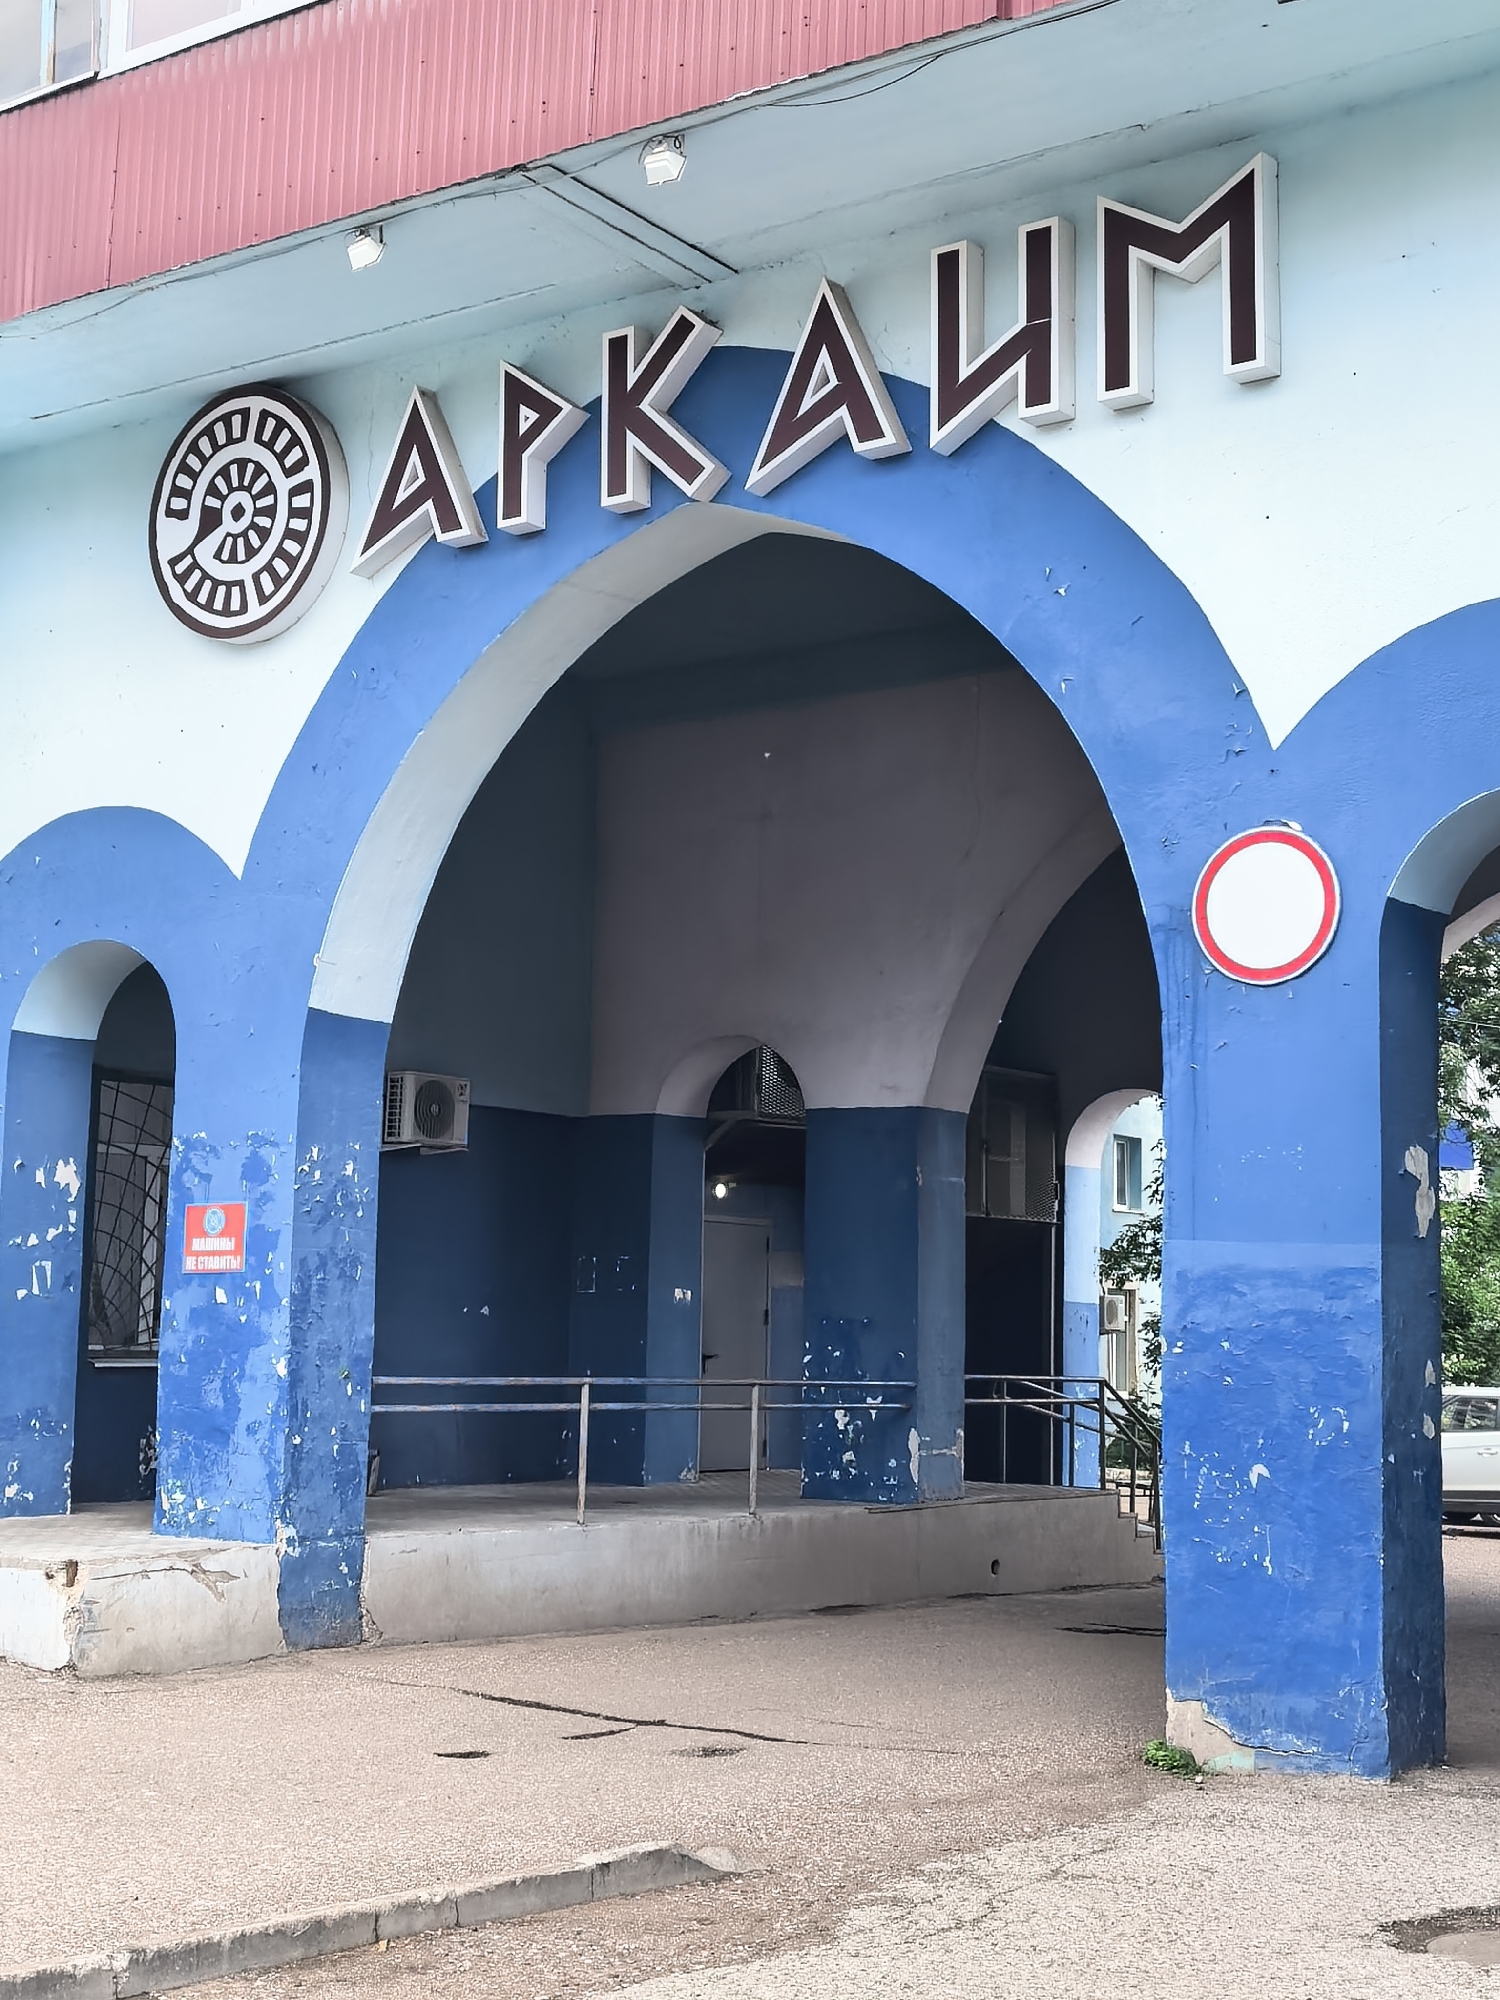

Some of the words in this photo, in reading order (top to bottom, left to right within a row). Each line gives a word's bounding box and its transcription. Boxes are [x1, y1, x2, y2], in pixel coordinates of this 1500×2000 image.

[351, 152, 1280, 577] АРКАИМ
[191, 1237, 235, 1251] МАШИНЫ
[185, 1256, 197, 1270] НЕ
[197, 1255, 241, 1270] СТАВИТЬ!
